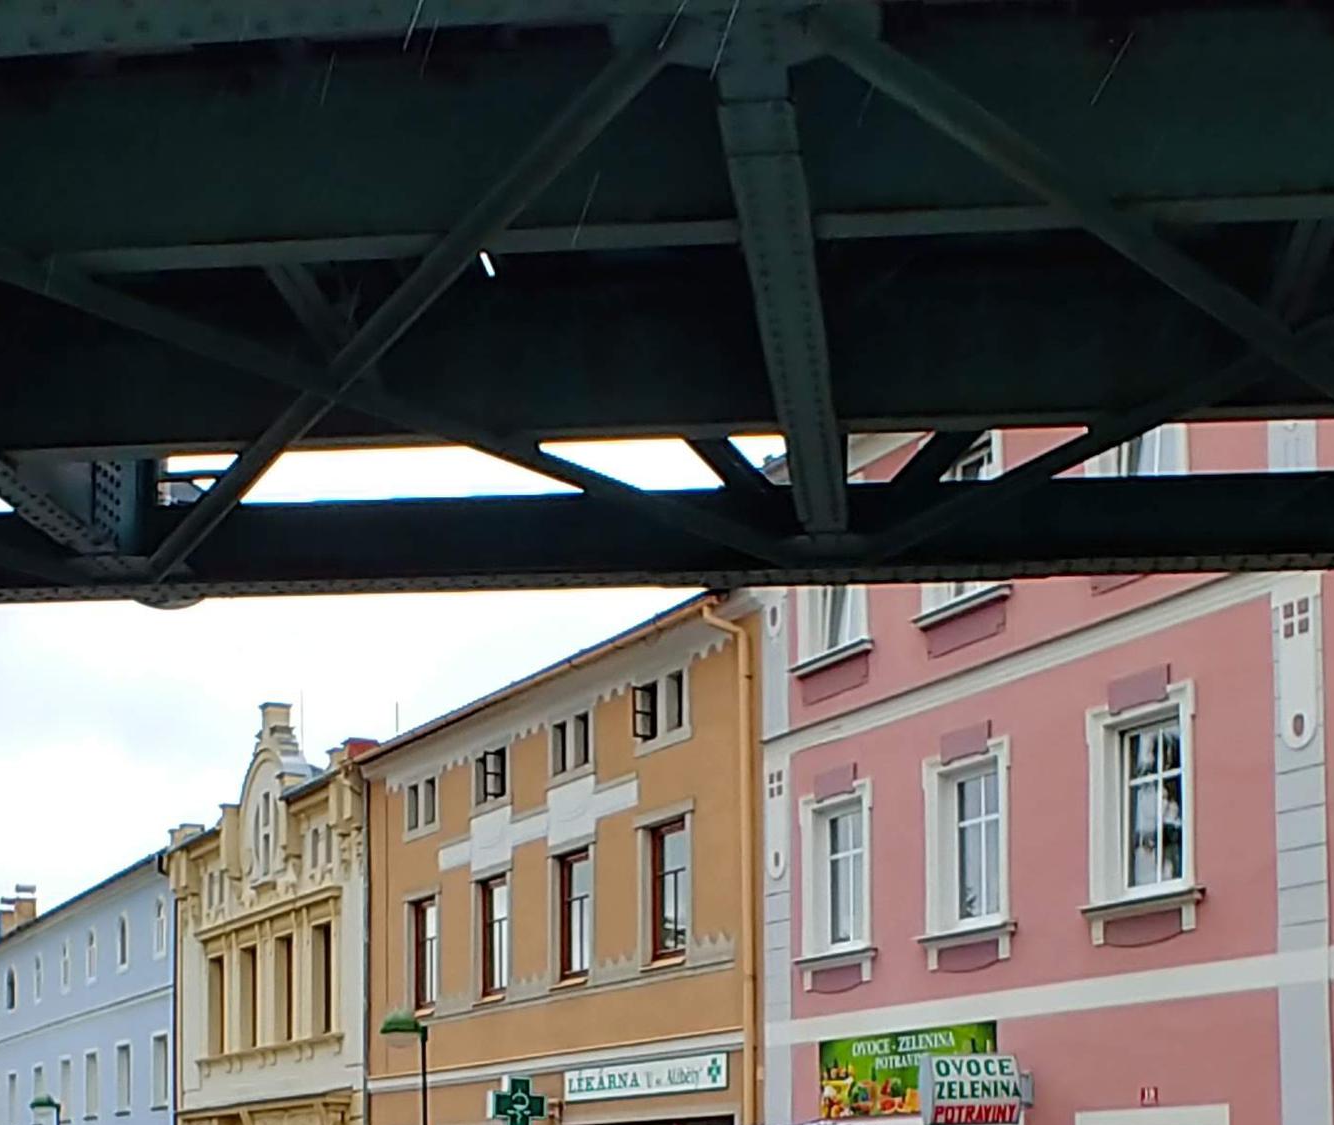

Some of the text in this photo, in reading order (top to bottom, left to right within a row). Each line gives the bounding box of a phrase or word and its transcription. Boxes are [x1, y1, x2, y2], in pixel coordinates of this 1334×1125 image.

[852, 1039, 890, 1056] OVOCE
[898, 1032, 955, 1051] ZELENINA
[936, 1059, 1014, 1077] OVOCE
[568, 1068, 640, 1093] LÉKÁRNA
[936, 1081, 1022, 1100] ZELENINA
[935, 1104, 1017, 1123] POTRAVINY
